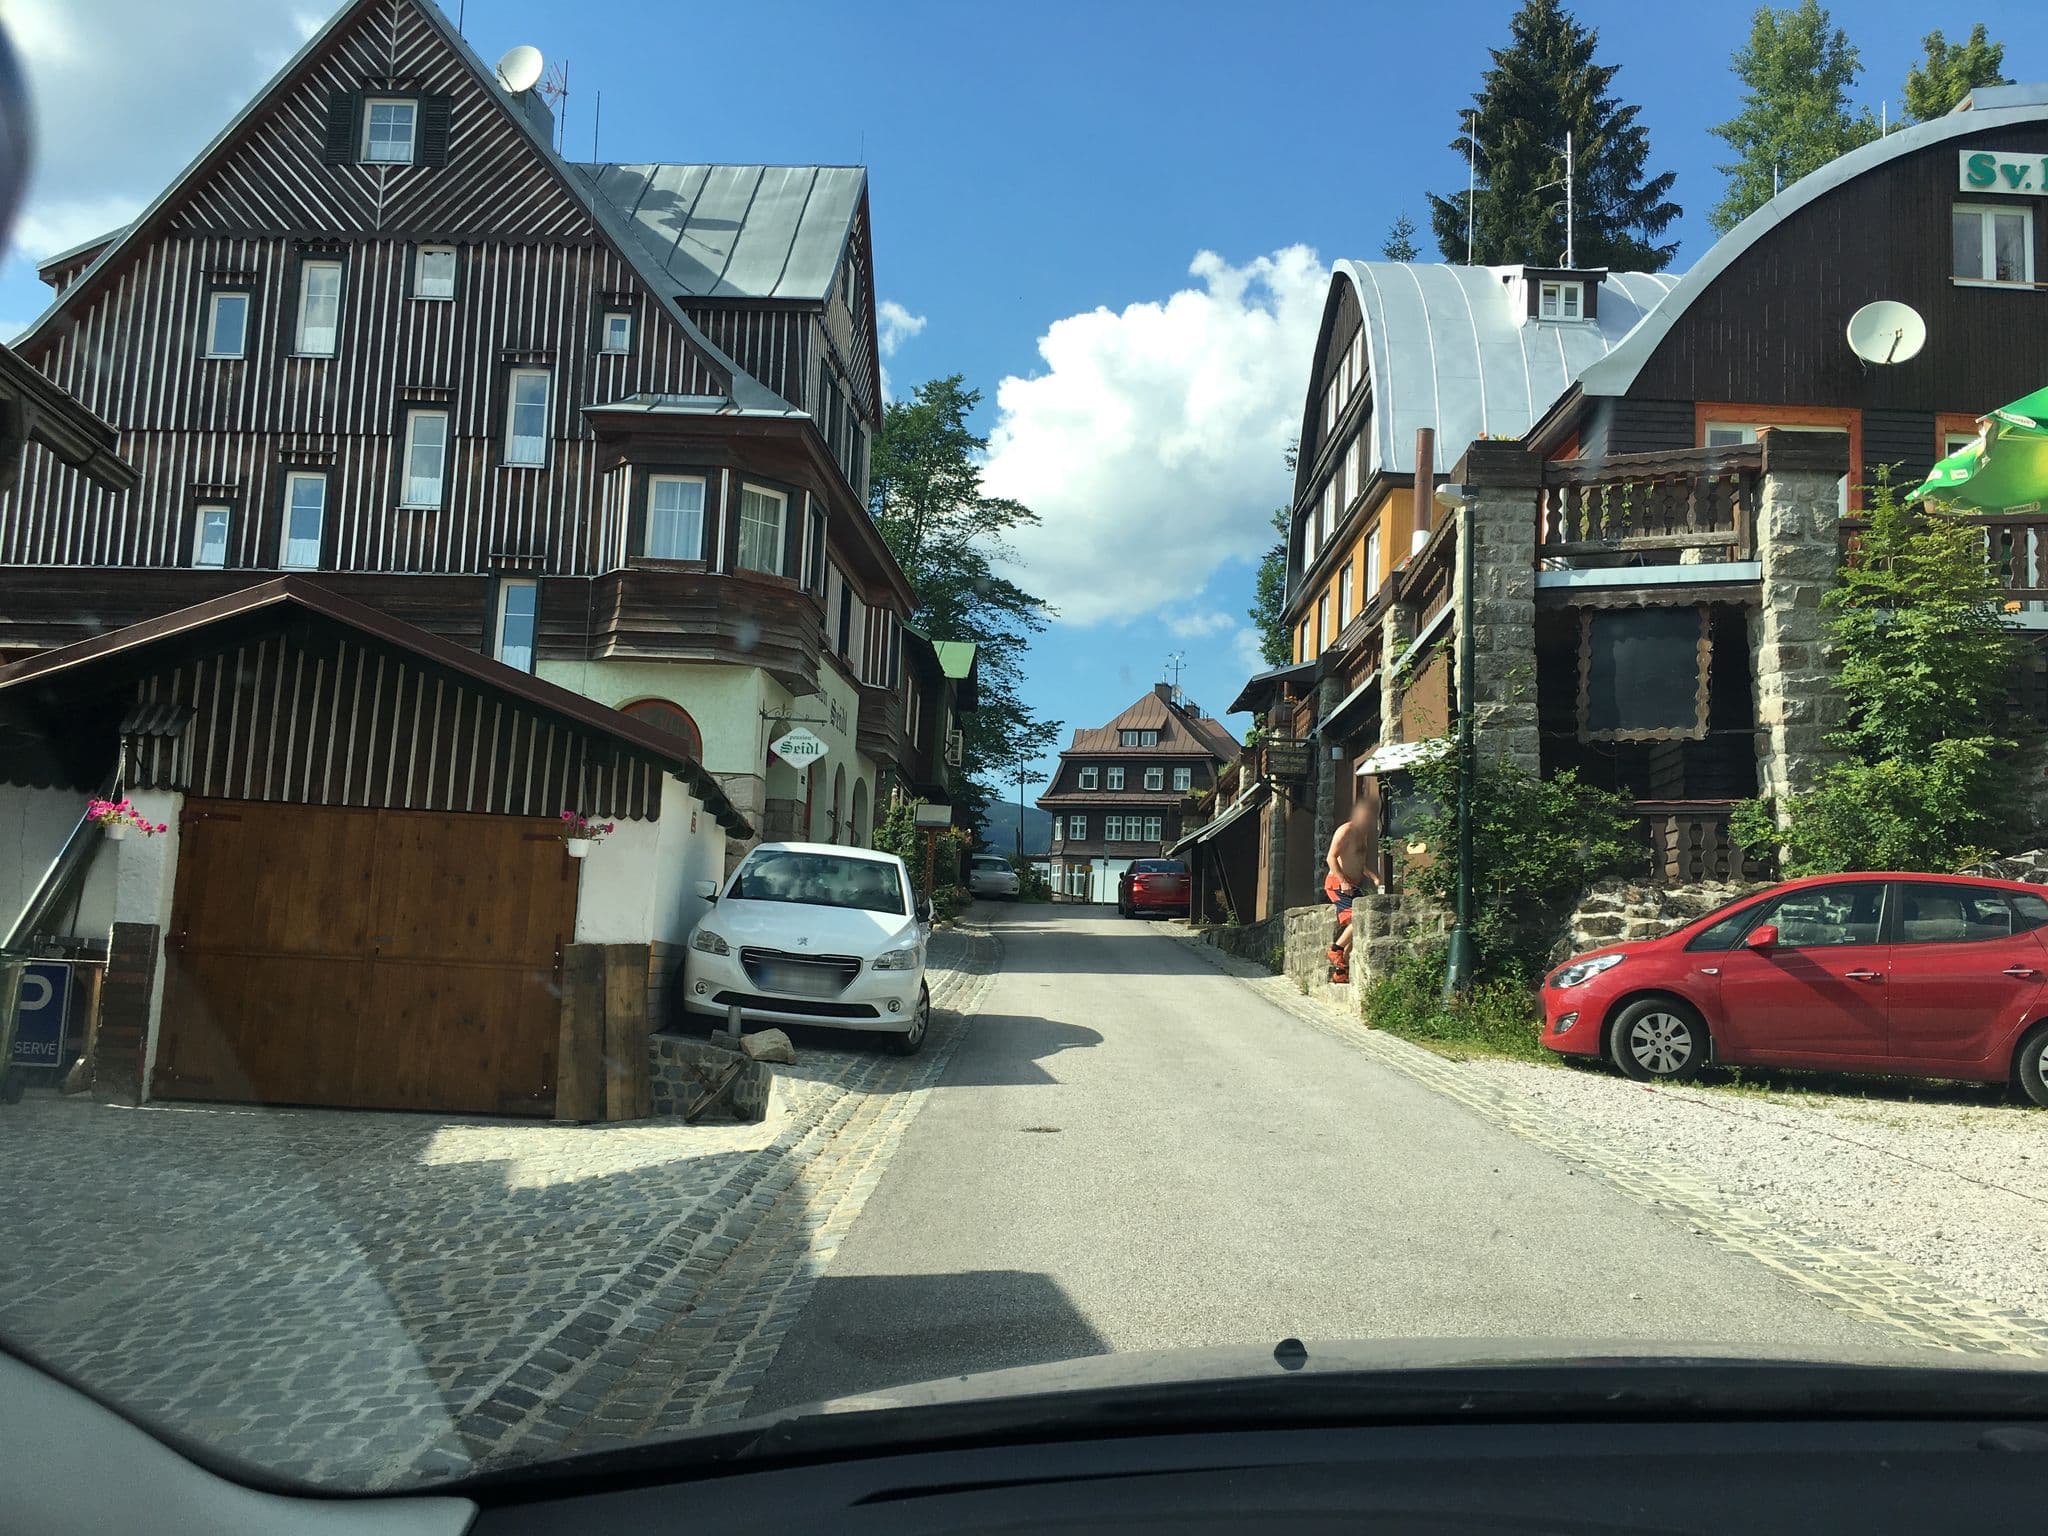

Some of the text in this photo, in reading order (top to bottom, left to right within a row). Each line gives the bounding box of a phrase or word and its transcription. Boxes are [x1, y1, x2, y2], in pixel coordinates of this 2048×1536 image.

[780, 741, 819, 755] Seidl
[17, 974, 53, 1031] P
[14, 1040, 57, 1056] SERVÉ
